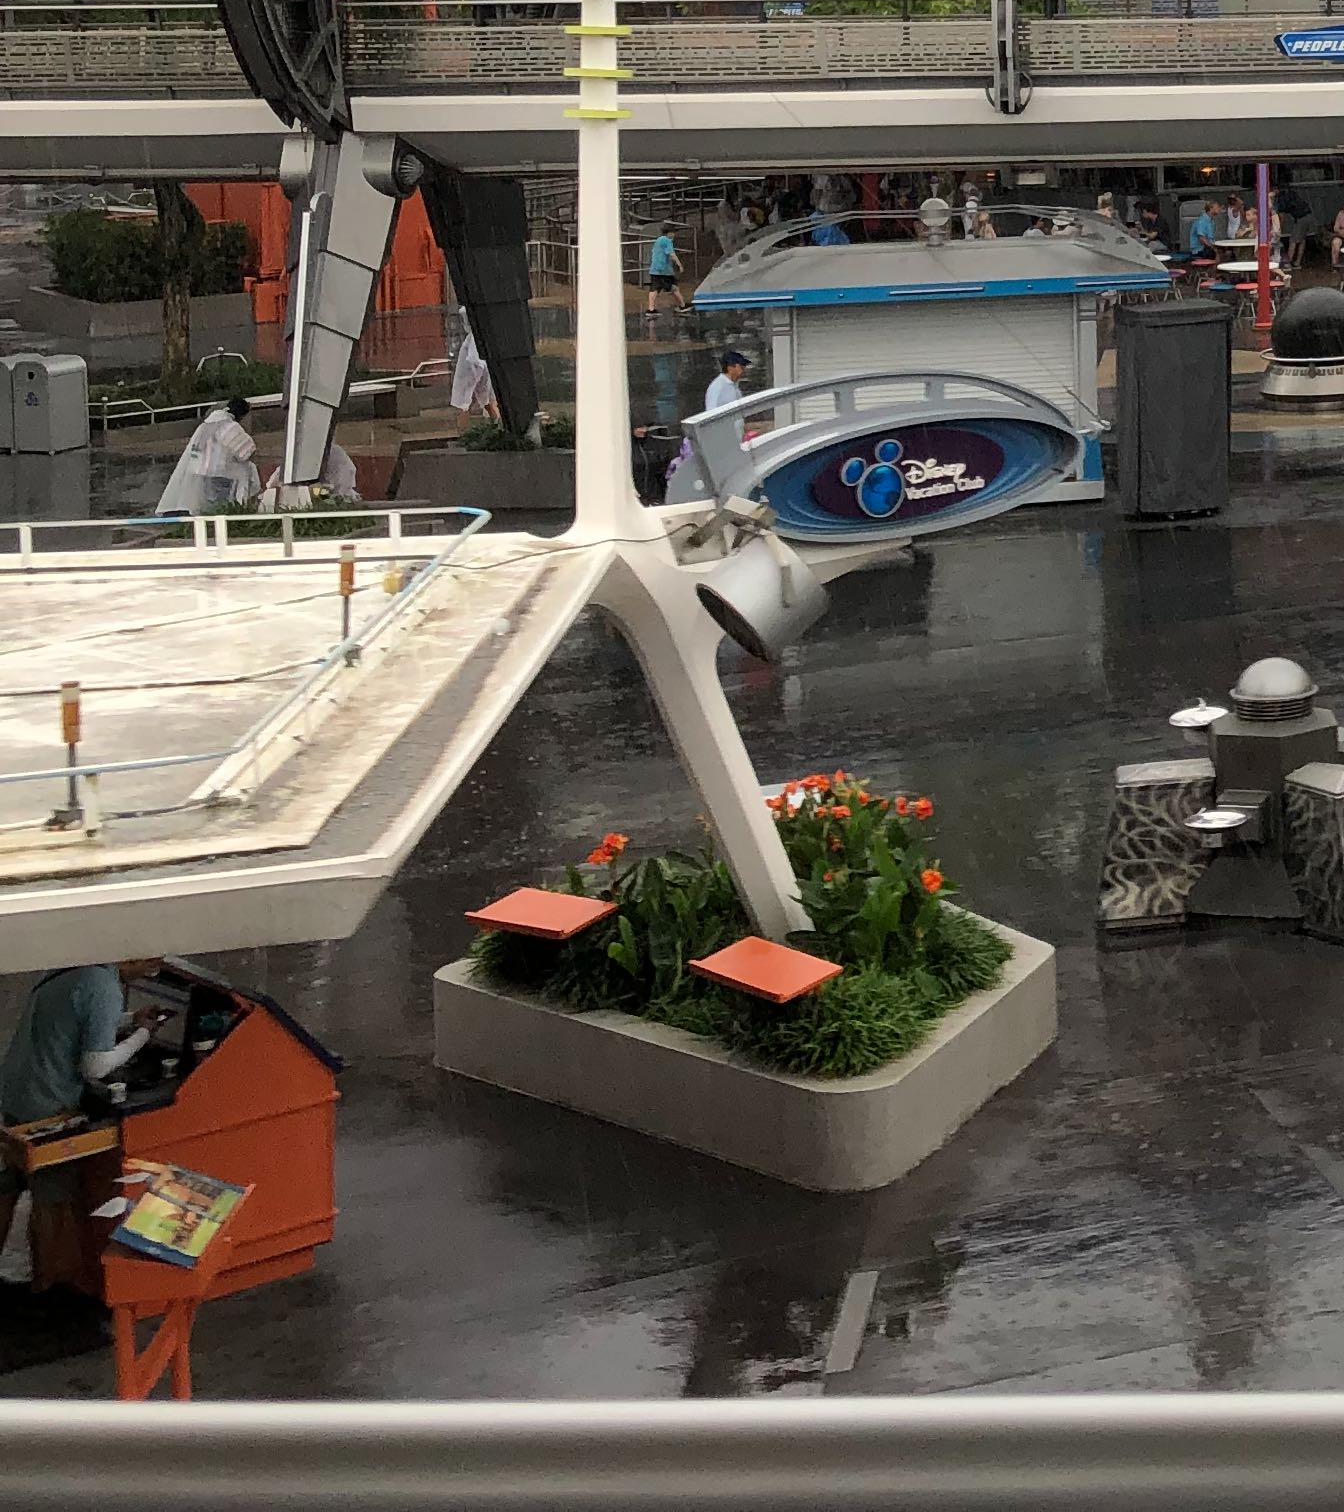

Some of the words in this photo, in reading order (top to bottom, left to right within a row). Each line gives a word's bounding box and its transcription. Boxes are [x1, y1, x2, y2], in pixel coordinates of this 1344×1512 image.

[900, 457, 967, 485] Disney
[904, 483, 956, 501] Vacation
[957, 475, 985, 491] Club
